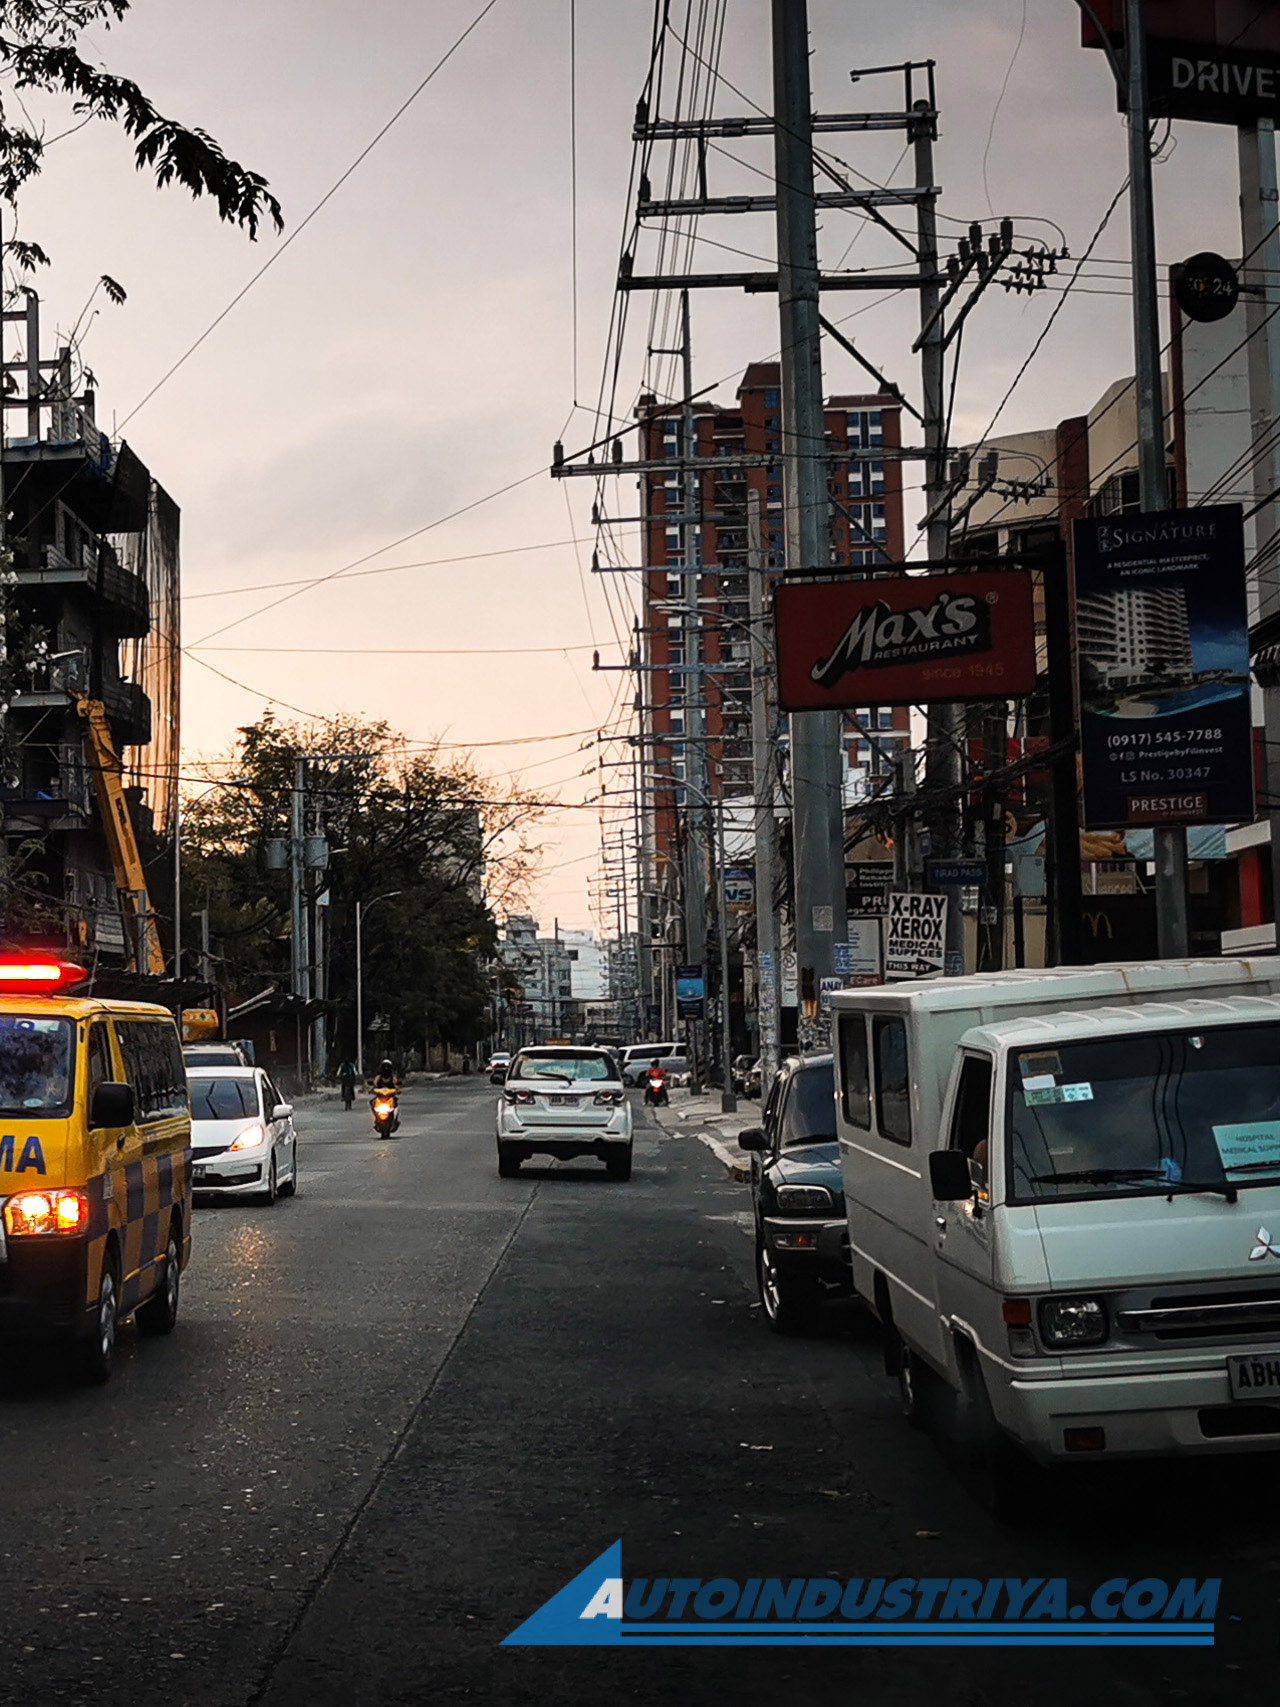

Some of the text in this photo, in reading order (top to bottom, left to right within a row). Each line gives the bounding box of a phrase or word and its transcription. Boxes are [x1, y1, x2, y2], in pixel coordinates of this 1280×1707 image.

[1171, 56, 1280, 100] DRIVE
[810, 592, 977, 681] Max's
[873, 634, 979, 661] RESTAURANT
[922, 666, 962, 680] since
[1107, 728, 1223, 748] (0917) 545-7788
[1120, 766, 1211, 783] LS No. 30347
[1131, 796, 1204, 812] PRESTIGE
[960, 867, 983, 877] PASS
[891, 895, 946, 919] X-RAY
[889, 917, 942, 941] XEROX
[888, 939, 942, 950] MEDICAL
[888, 948, 942, 958] SUPPLIES
[888, 962, 932, 971] THIS WAY
